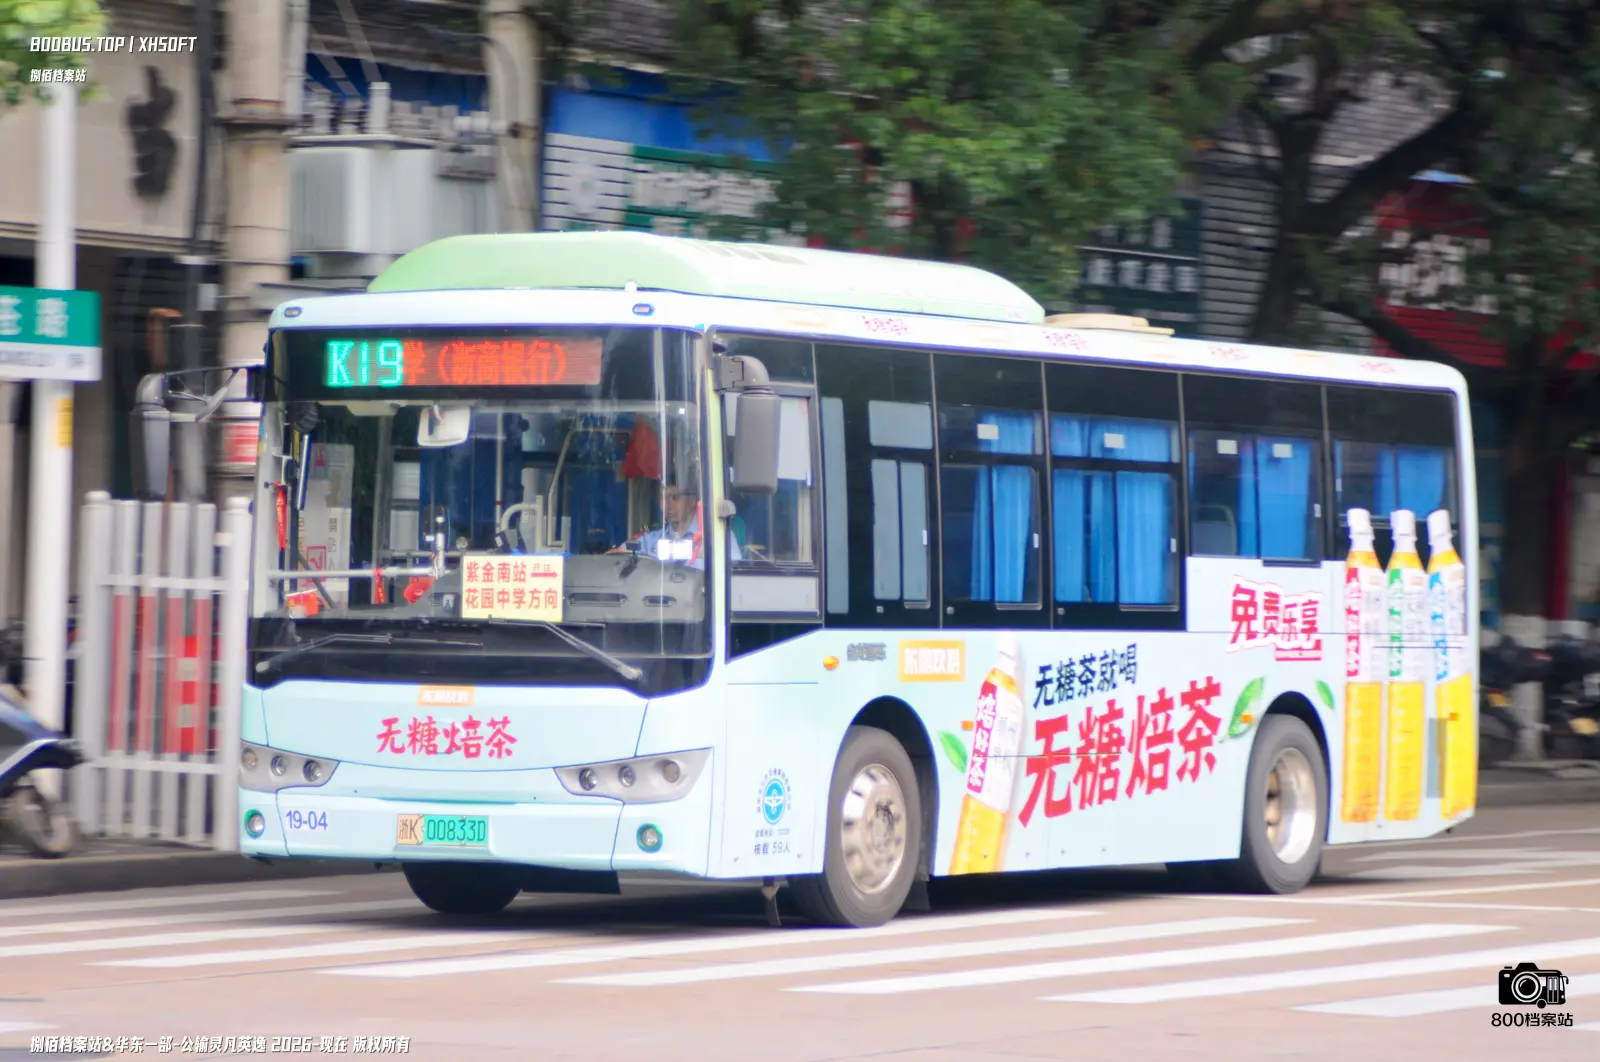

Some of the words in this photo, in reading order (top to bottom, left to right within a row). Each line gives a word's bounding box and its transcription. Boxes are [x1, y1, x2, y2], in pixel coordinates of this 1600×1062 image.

[325, 339, 404, 387] K19
[466, 561, 527, 583] 紫金南站
[465, 587, 558, 609] 花园中学方向
[1230, 583, 1319, 645] 免费乐享
[1033, 643, 1138, 709] 无糖茶就喝
[376, 714, 518, 759] 无糖焙茶
[1018, 675, 1222, 828] 无糖焙茶
[285, 810, 328, 831] 19-04
[426, 819, 487, 842] 00833D
